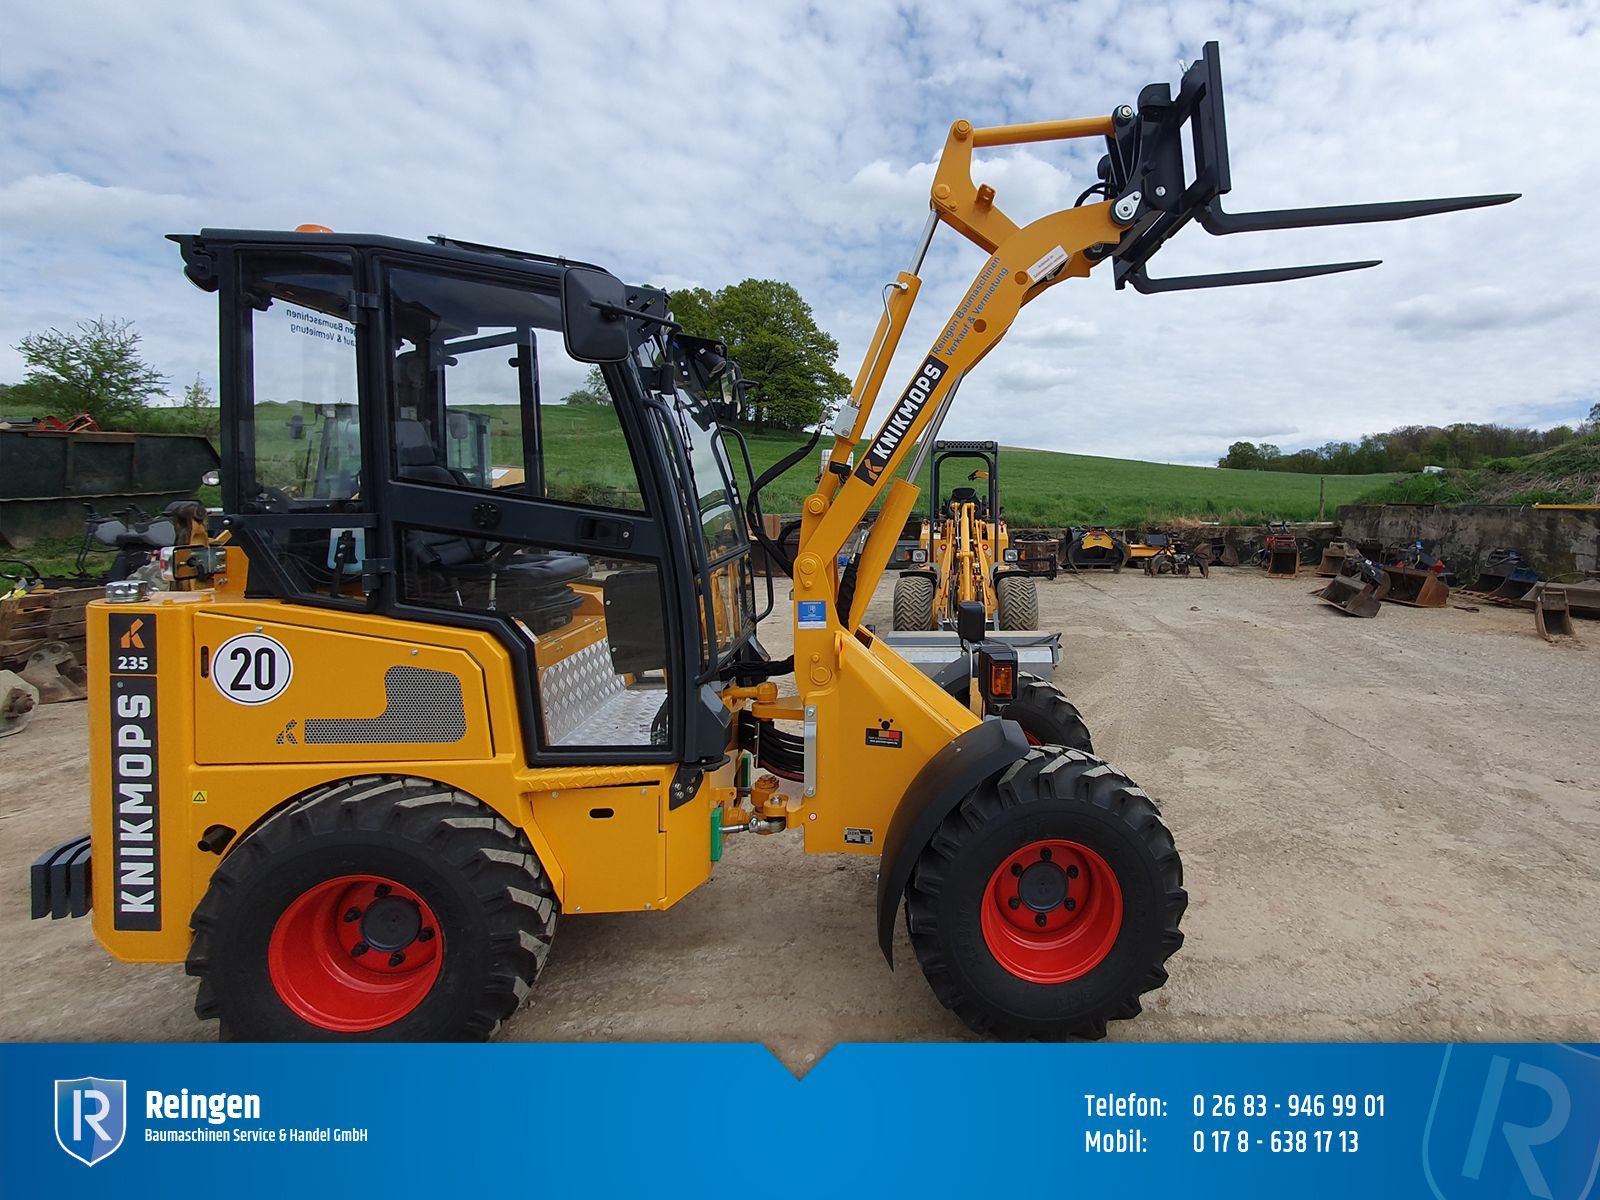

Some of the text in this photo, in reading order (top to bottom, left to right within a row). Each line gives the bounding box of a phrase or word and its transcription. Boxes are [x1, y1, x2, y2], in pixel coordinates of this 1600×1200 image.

[932, 256, 1001, 356] Reingen Baumaschinen
[944, 267, 1009, 357] Verkauf & Vermietung
[872, 363, 942, 460] KNIKMOPS
[117, 656, 149, 670] 235
[230, 646, 276, 691] 20
[117, 694, 155, 912] KNIKMOPS
